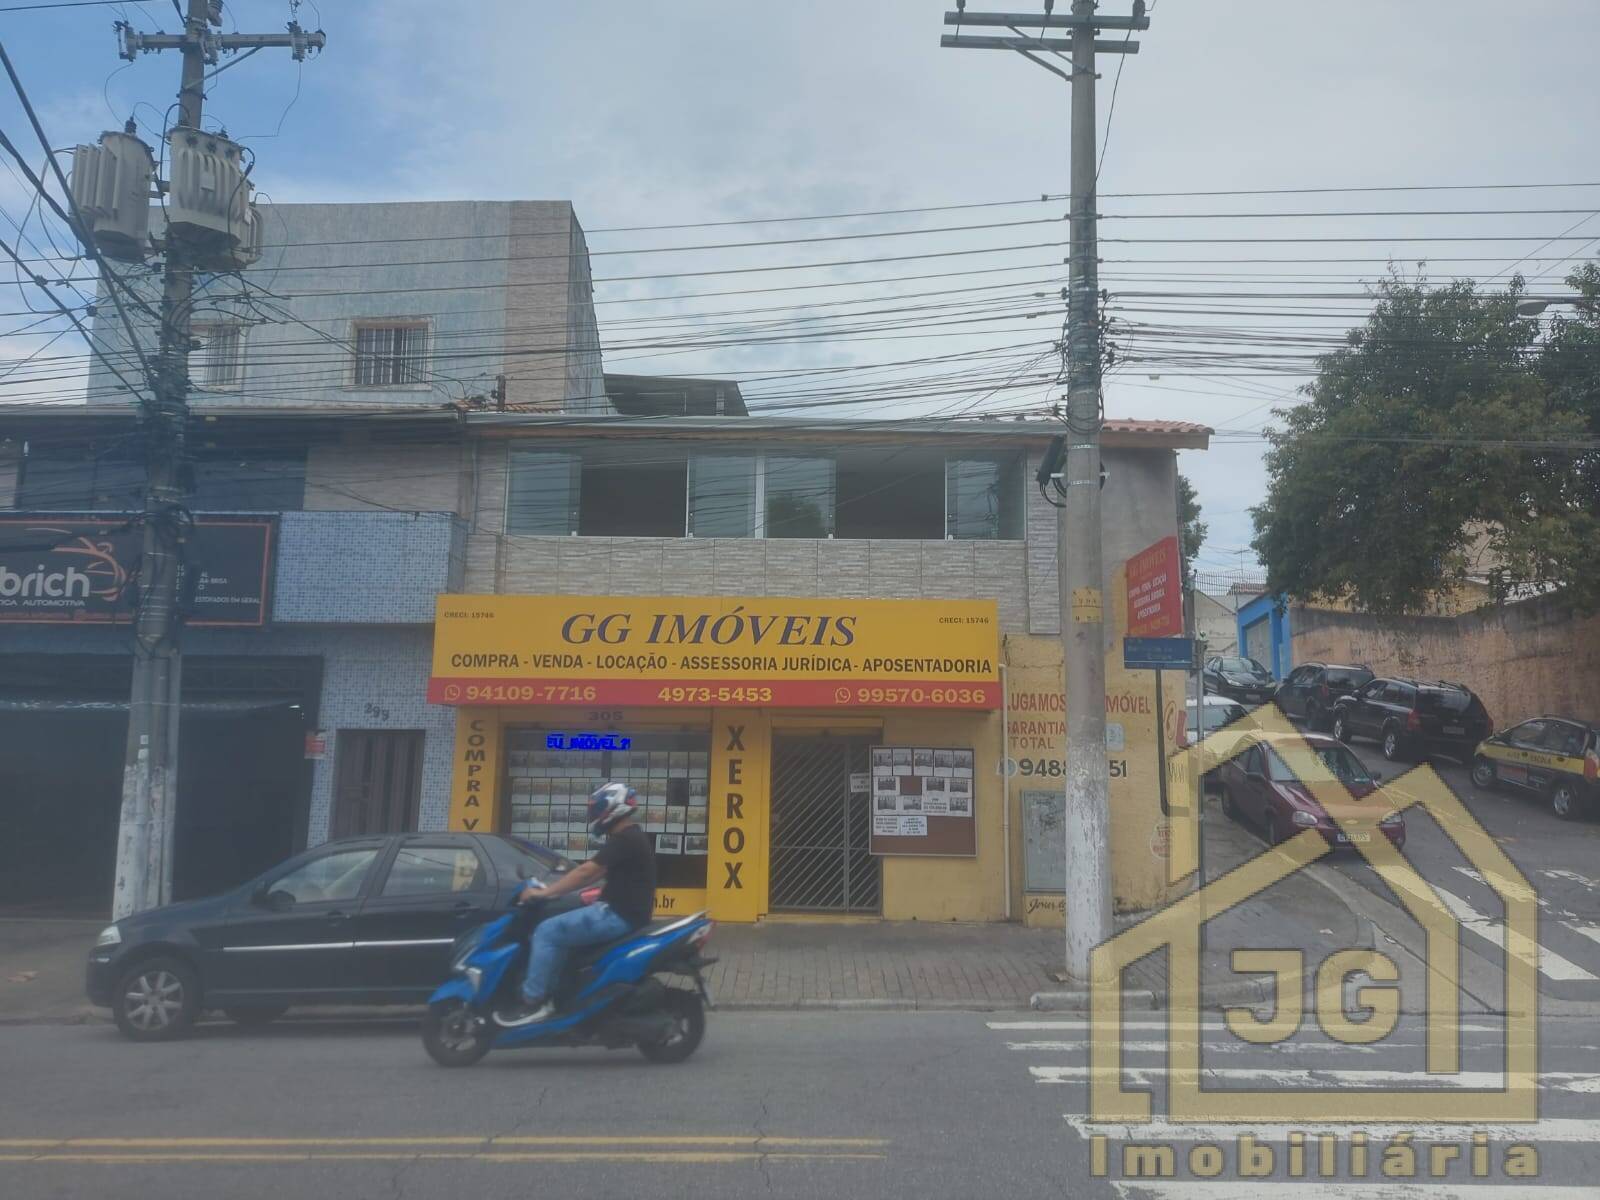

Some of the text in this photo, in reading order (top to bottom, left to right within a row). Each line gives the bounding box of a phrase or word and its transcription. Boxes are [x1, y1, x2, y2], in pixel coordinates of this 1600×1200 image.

[561, 606, 857, 647] GG IMÓVEIS
[966, 616, 990, 625] 15746
[451, 651, 992, 674] COMPRA VENDA LOCAÇÃO ASSESSORIA JURÍDICA APOSENTADORIA
[466, 685, 597, 701] 94109-7716
[657, 687, 773, 702] 4973-5453
[857, 687, 986, 704] 99570-6036
[1006, 690, 1151, 714] UGAMOS MÓVEL
[588, 711, 625, 722] 305
[1010, 736, 1055, 750] TOTAL
[464, 719, 486, 808] COMPRA
[723, 725, 746, 890] XEROX
